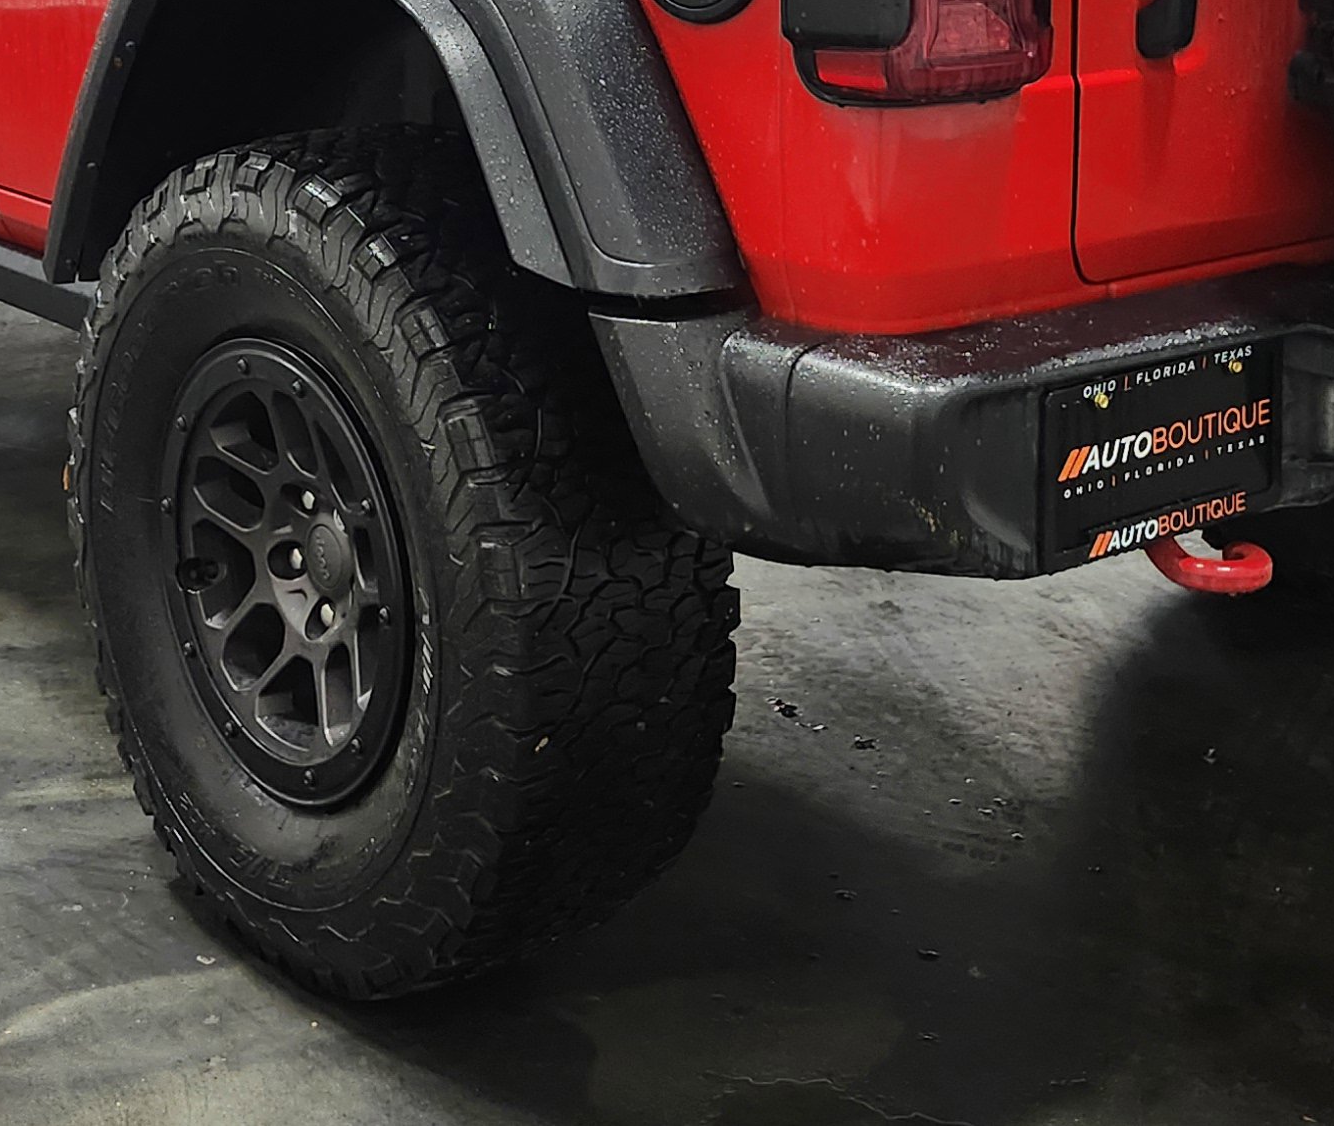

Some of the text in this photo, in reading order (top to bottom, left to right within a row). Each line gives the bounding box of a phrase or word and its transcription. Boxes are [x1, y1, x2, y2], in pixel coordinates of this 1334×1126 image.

[1083, 345, 1252, 398] OHIO FLORIDA TEXAS
[1064, 434, 1266, 499] OHIO FLORIDA TEXAS
[1081, 399, 1271, 474] AUTOBOUTIQUE
[1106, 491, 1247, 553] AUTOBOUTIQUE
